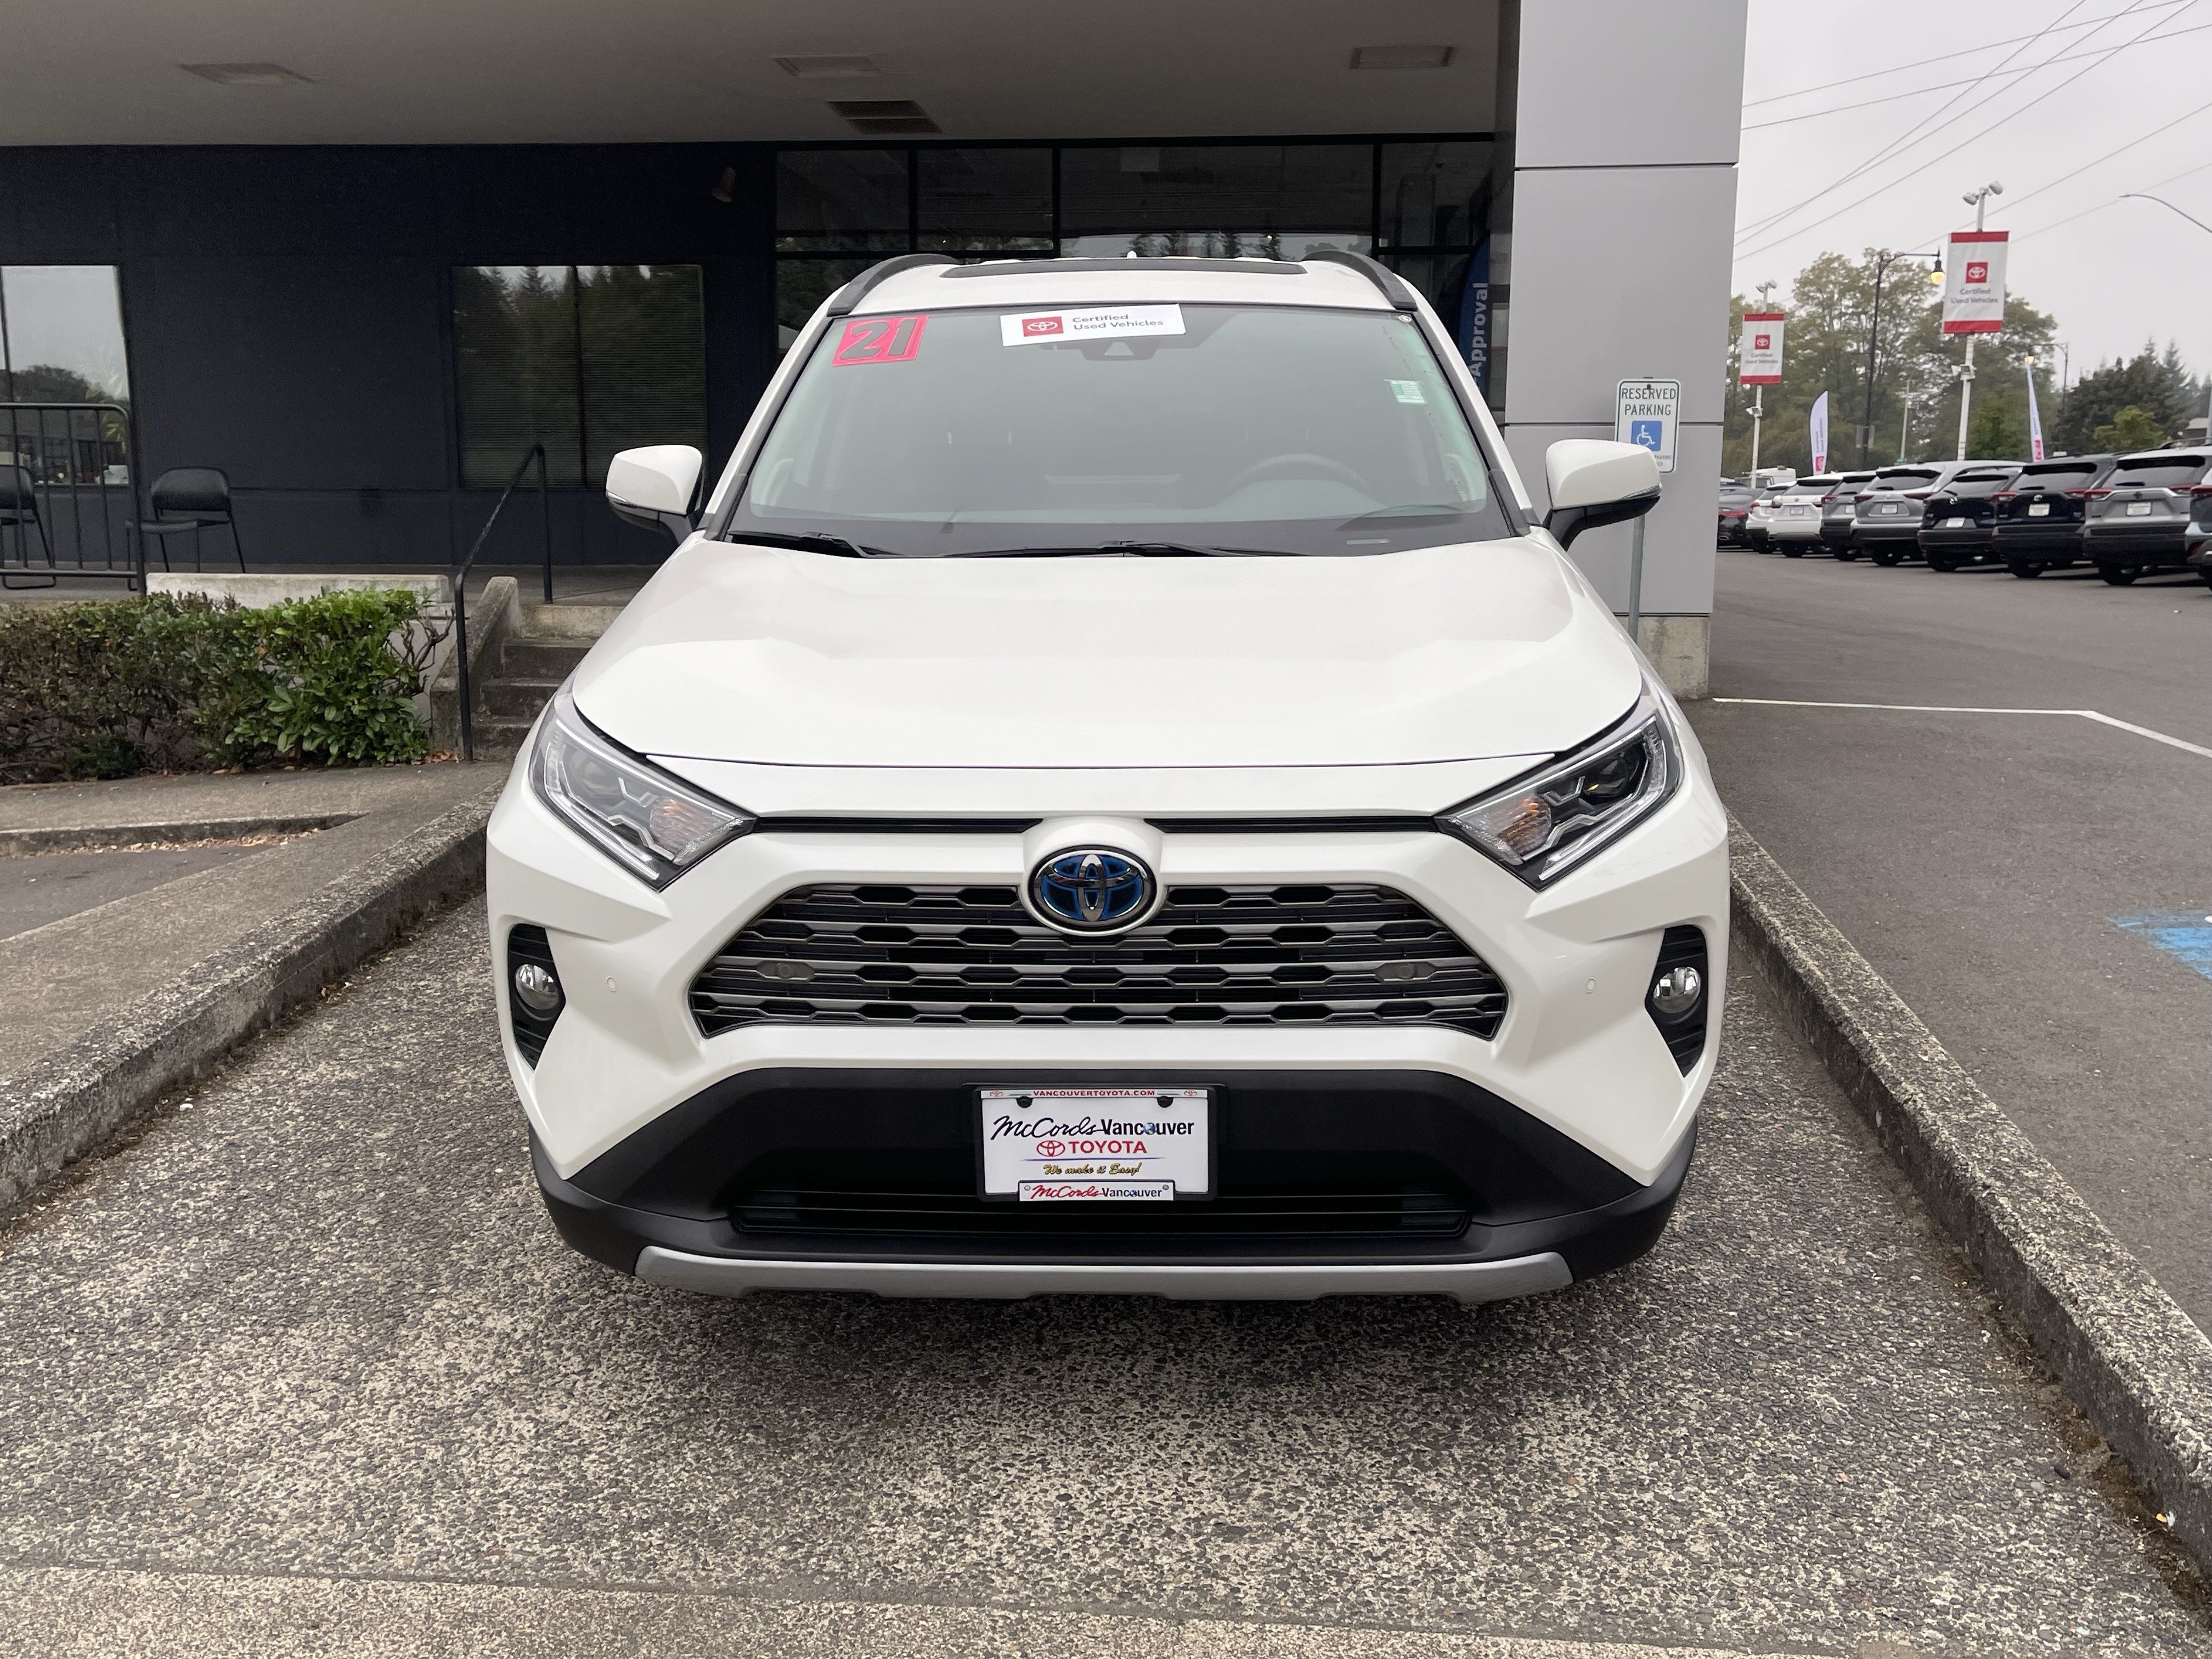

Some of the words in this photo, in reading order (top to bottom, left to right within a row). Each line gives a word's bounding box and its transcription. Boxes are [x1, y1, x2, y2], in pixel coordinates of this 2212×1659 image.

[1071, 313, 1129, 323] Certified
[1073, 322, 1107, 330] Used
[1111, 319, 1164, 328] Vehicles
[1468, 282, 1489, 377] Approval
[839, 319, 917, 360] 21
[1621, 387, 1677, 400] RESERVED
[1624, 403, 1672, 416] PARKING
[1068, 1140, 1148, 1154] TOYOTA
[1043, 1164, 1062, 1175] We
[1064, 1163, 1094, 1175] make
[1096, 1164, 1107, 1175] it
[1108, 1161, 1143, 1177] Easy!
